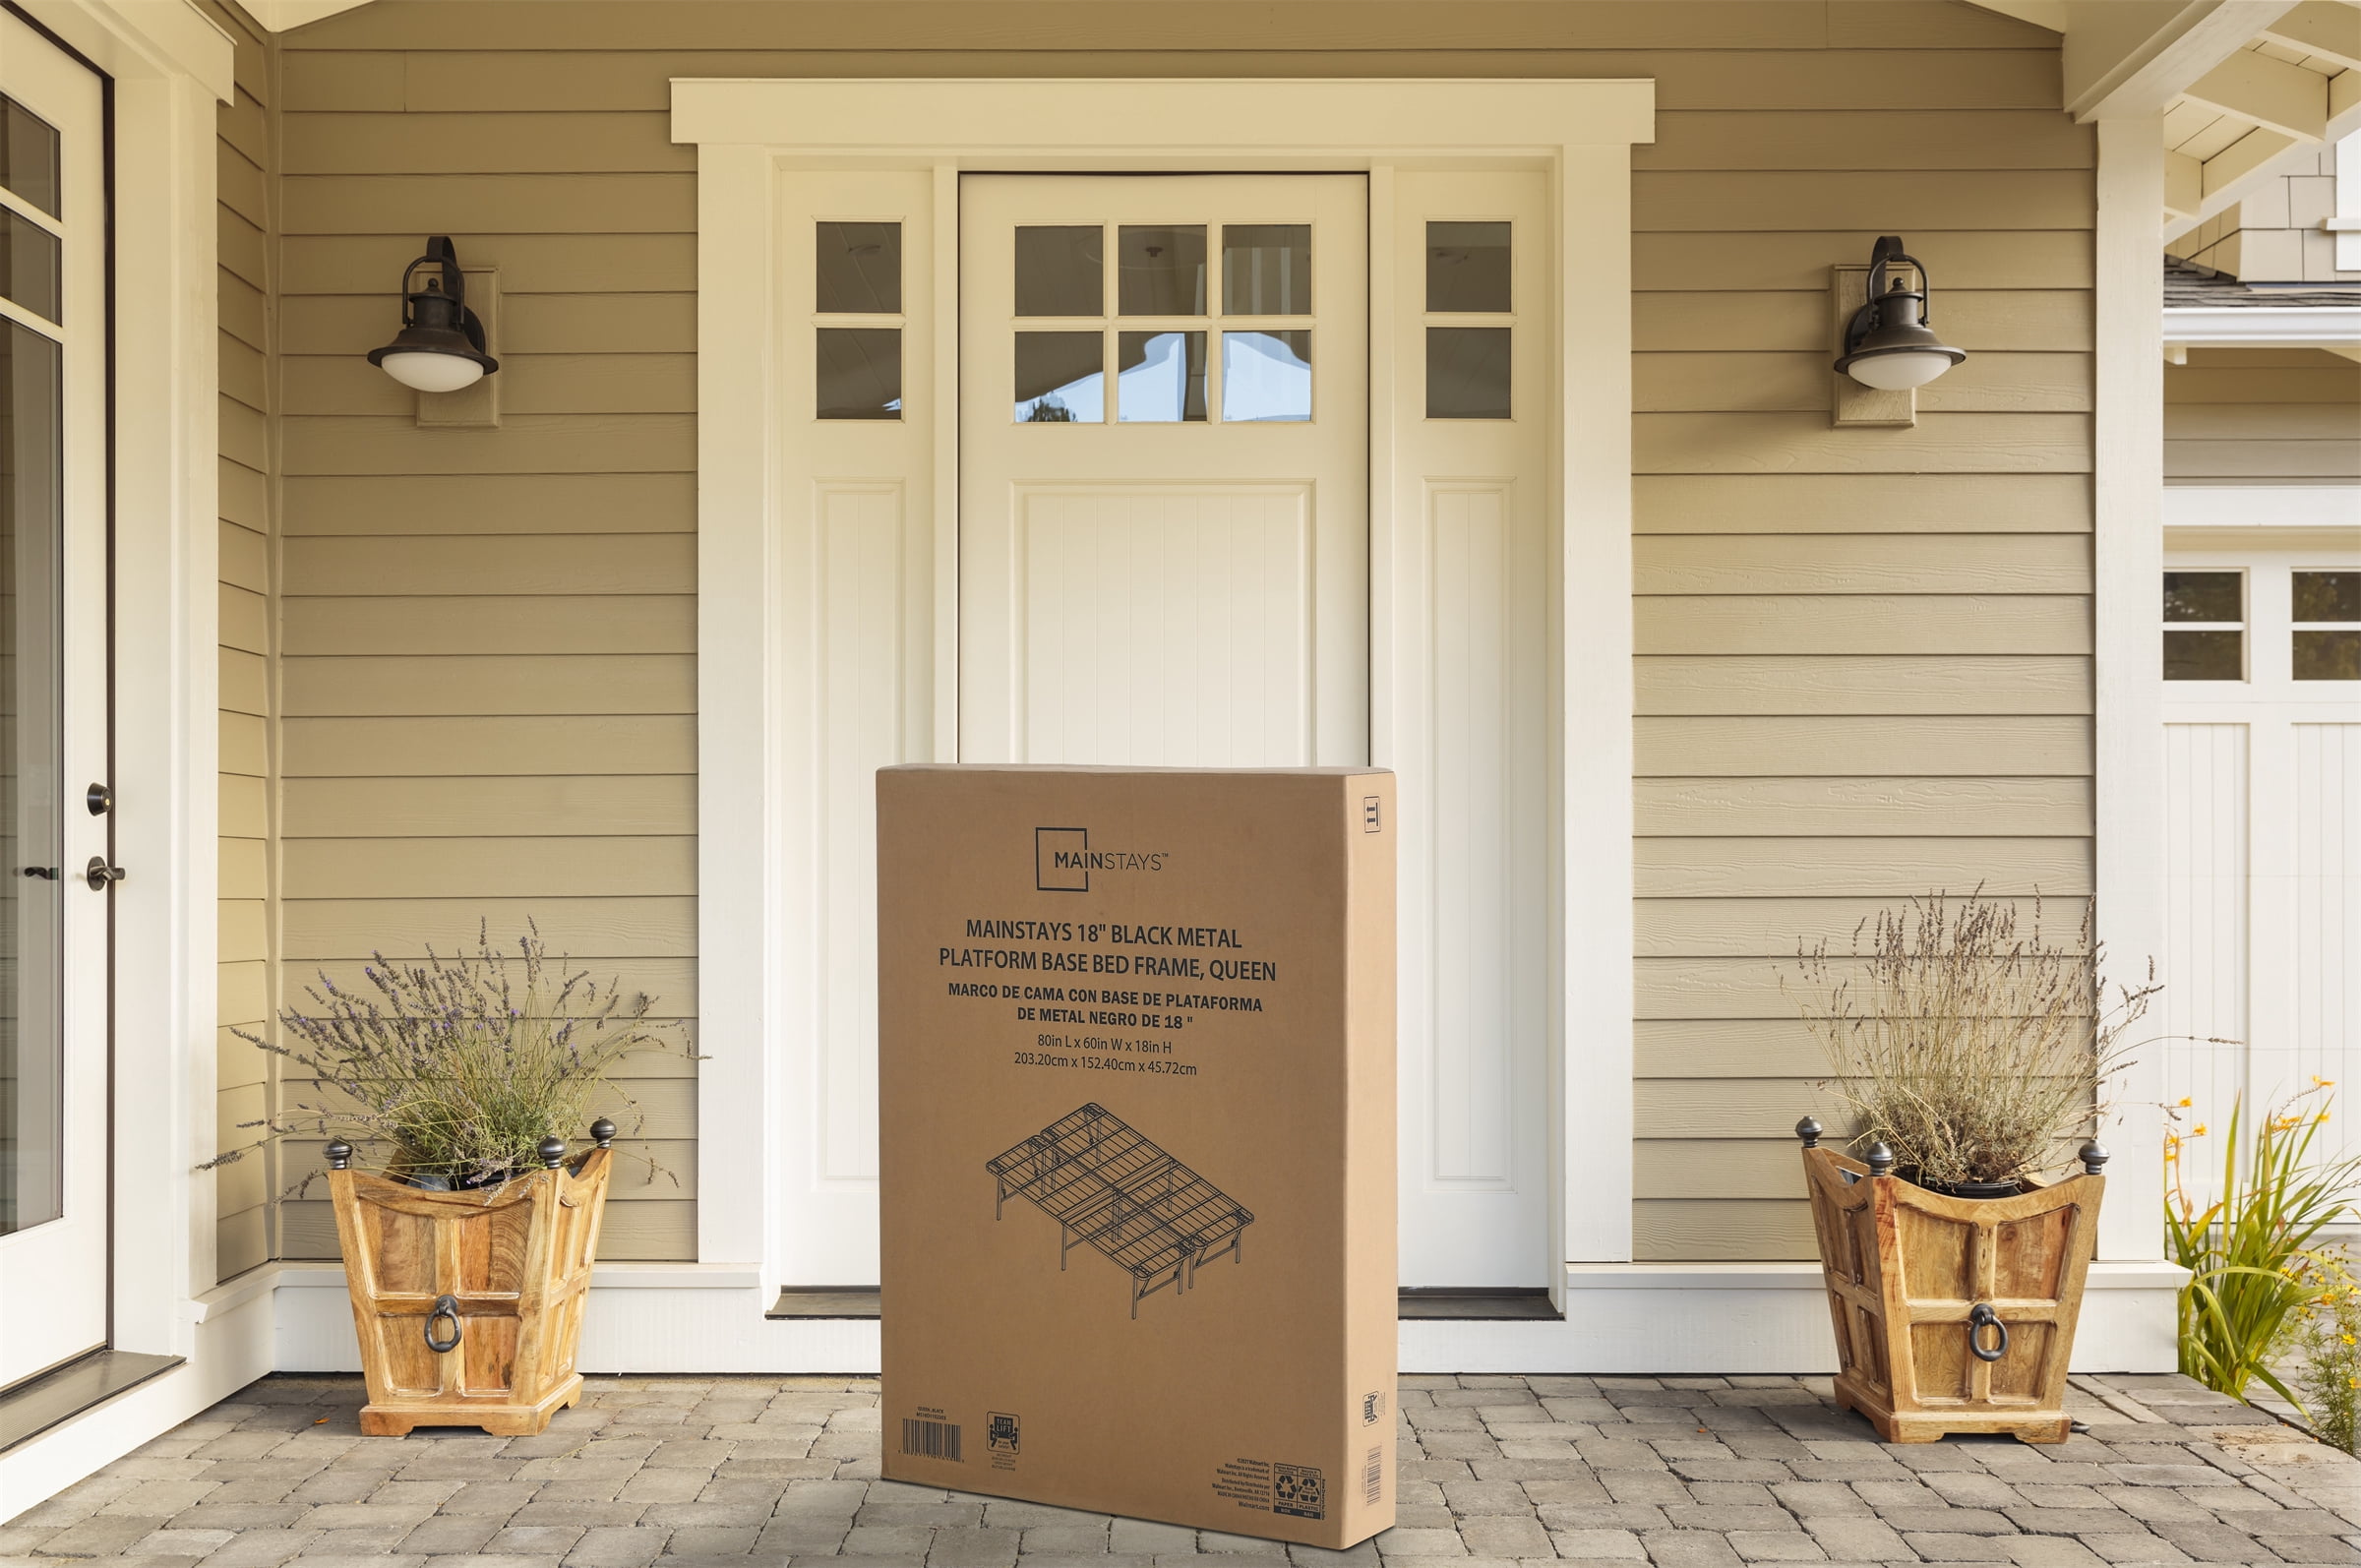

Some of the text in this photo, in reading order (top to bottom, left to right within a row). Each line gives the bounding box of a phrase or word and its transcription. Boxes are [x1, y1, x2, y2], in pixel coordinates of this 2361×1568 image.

[966, 919, 1242, 948] MAINSTAYS 18" BLACK METAL
[939, 947, 1276, 982] PLATFORM BASE BED FRAME, QUEEN
[948, 982, 1263, 1012] MARCO DE CAMA CON BASE DE PLATAFORMA
[1017, 1006, 1036, 1021] DE
[1039, 1007, 1086, 1024] METAL
[1089, 1010, 1137, 1027] NEGRO
[1141, 1013, 1161, 1028] DE
[1164, 1014, 1183, 1030] 18
[1037, 1034, 1172, 1055] 80in L x 60in W x 18in H
[1014, 1052, 1197, 1076] 203.20cm x 152.40cm x 45.72cm
